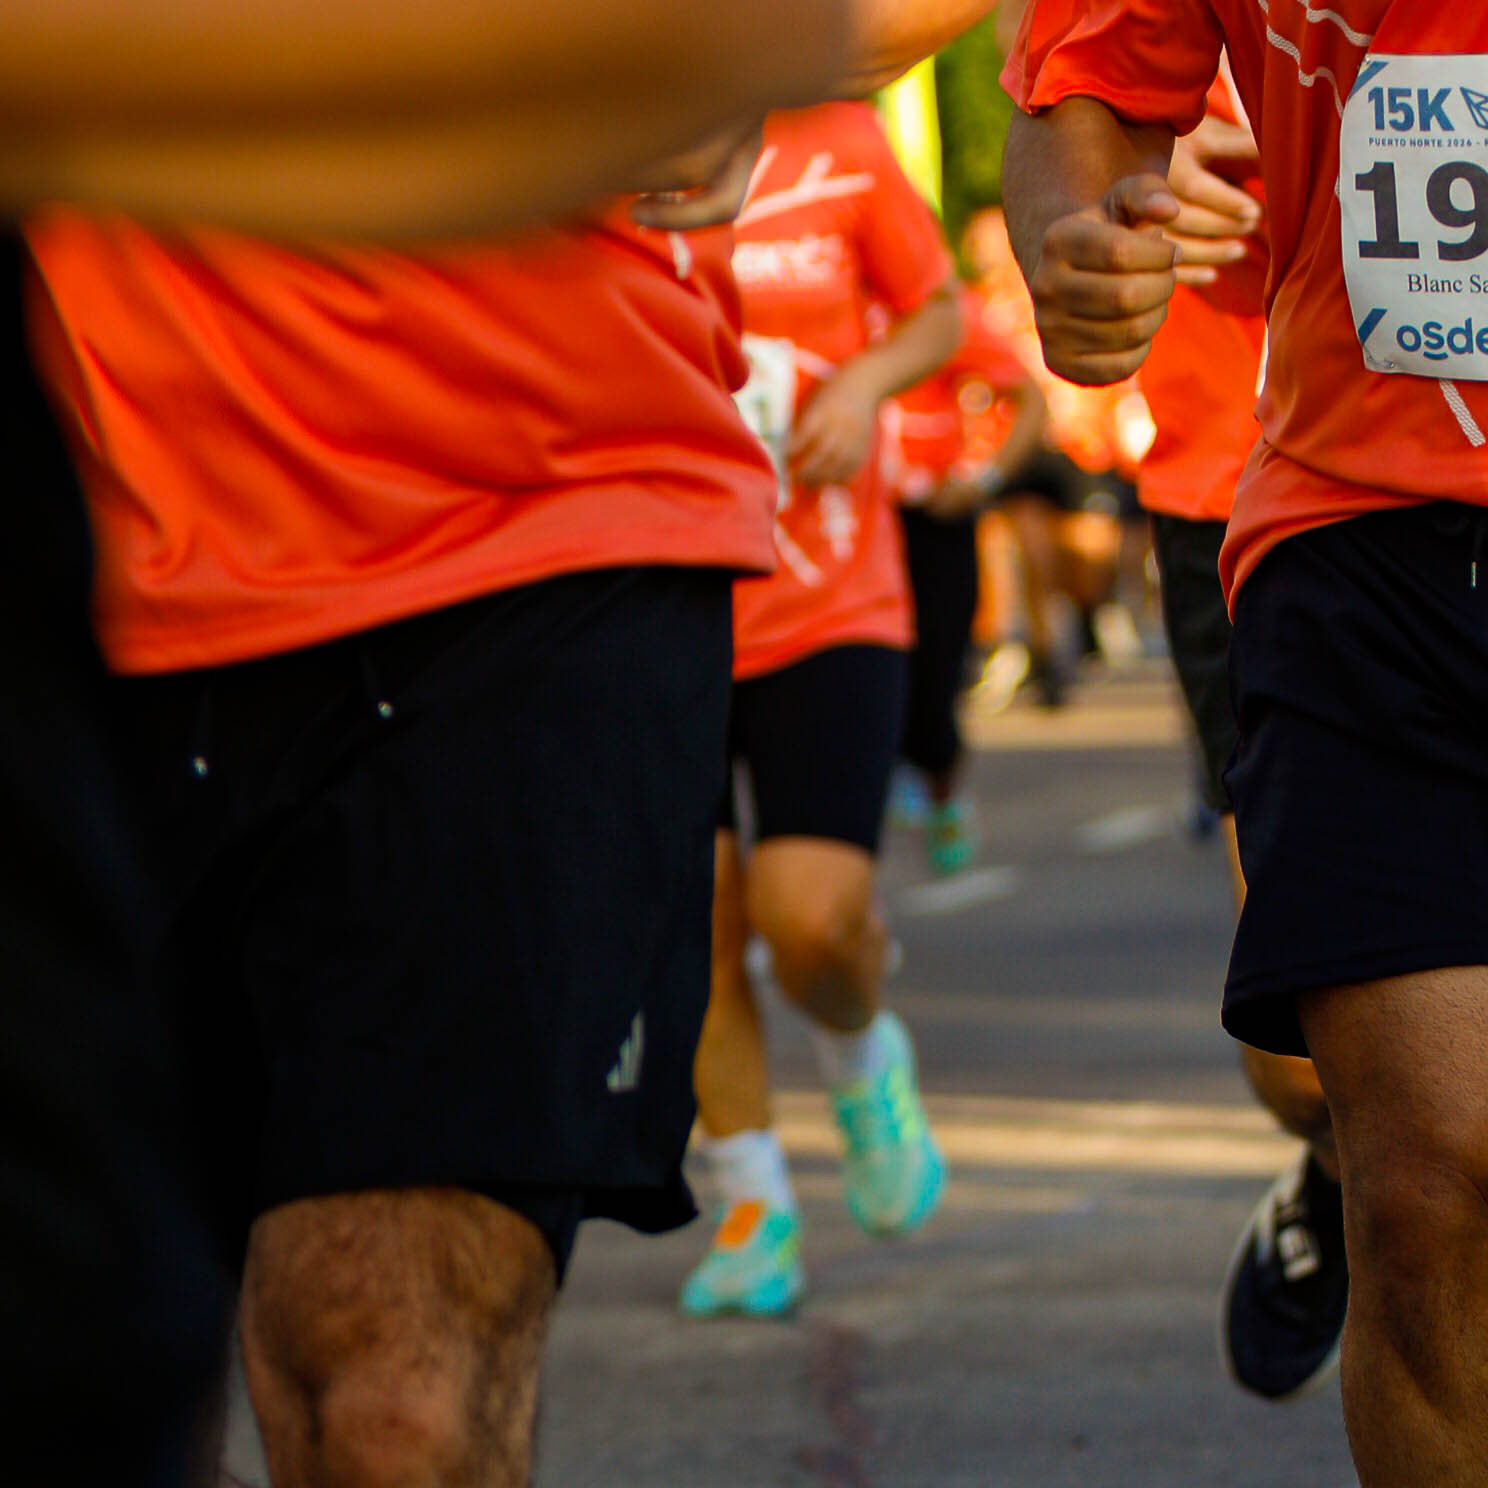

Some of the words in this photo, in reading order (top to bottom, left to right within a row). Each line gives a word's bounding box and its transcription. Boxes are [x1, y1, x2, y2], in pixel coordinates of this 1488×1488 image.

[1368, 86, 1455, 132] 15K
[1368, 137, 1406, 147] PUERTO
[1410, 137, 1442, 147] NORTE
[1407, 273, 1463, 293] Blanc
